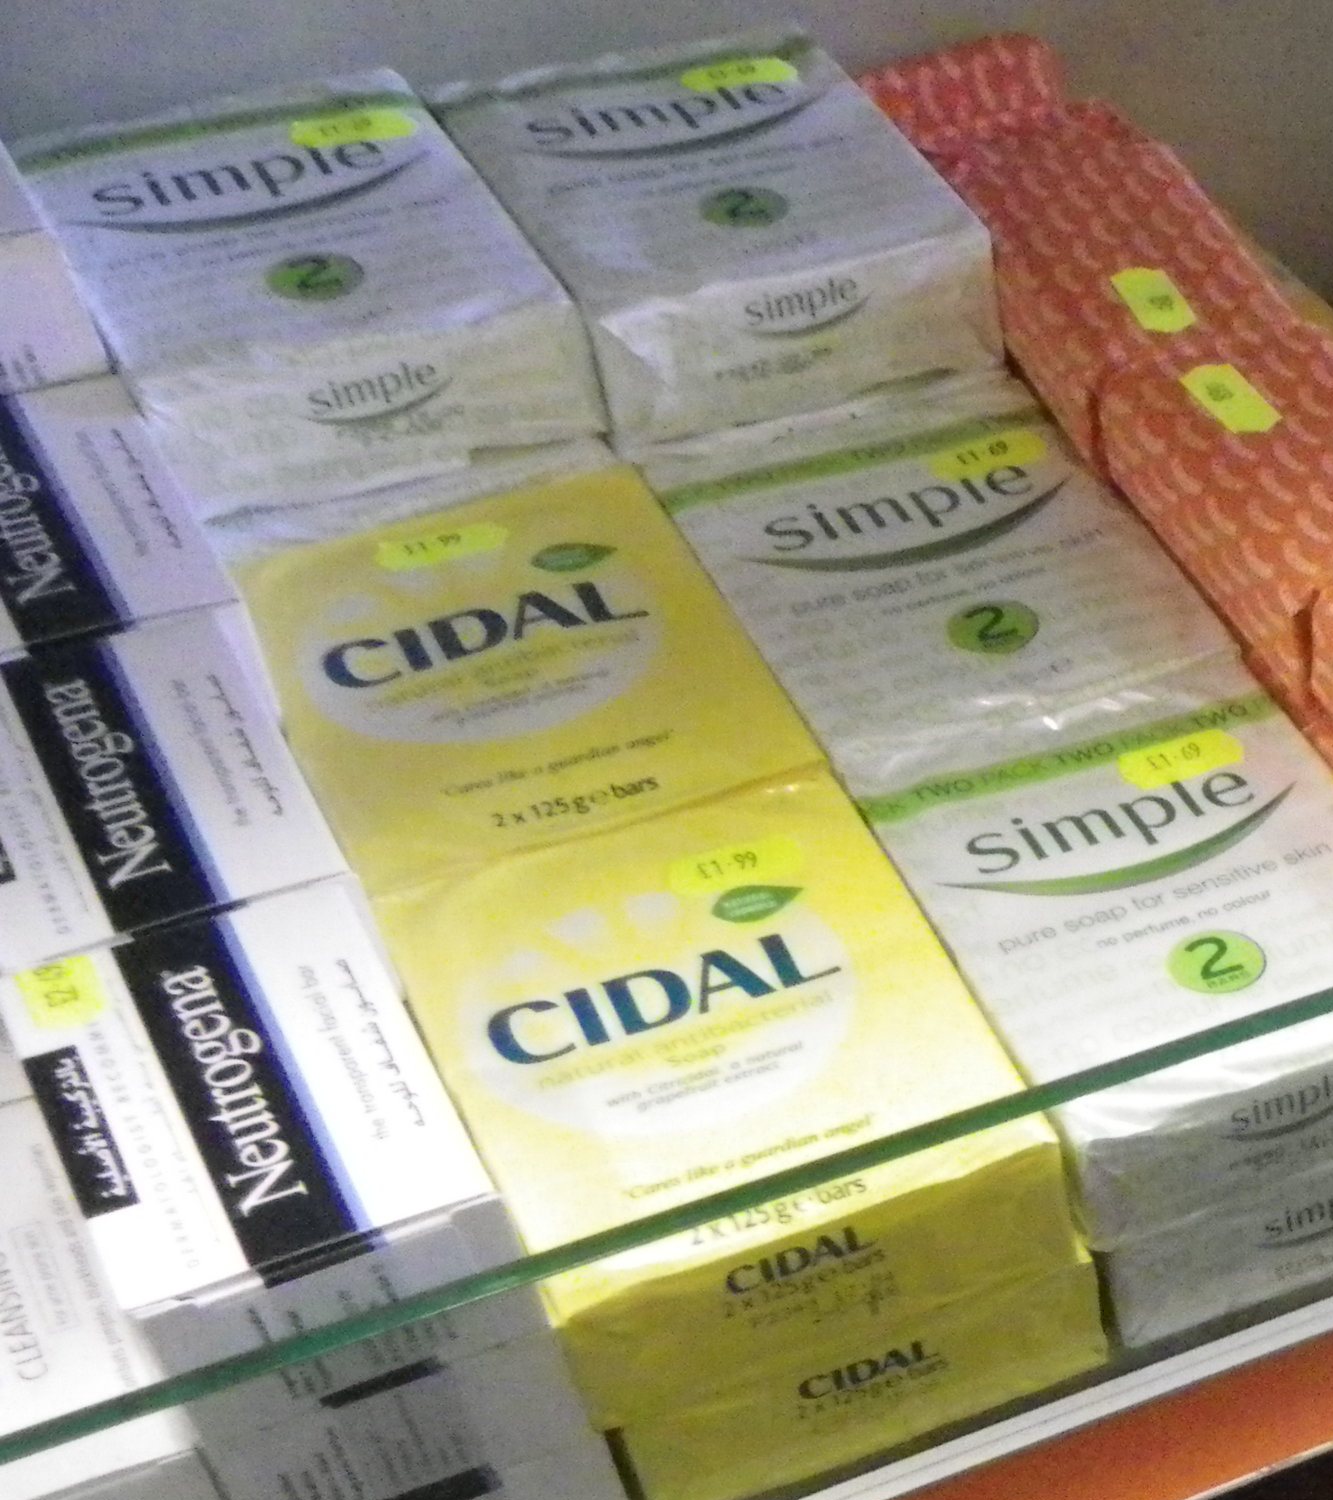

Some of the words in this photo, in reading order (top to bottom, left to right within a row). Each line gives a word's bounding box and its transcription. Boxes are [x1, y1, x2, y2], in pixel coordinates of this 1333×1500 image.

[527, 80, 785, 144] simple
[93, 142, 383, 217] simple
[744, 276, 859, 326] simple
[307, 362, 438, 416] simple
[0, 452, 76, 604] Neutroge
[765, 464, 1036, 552] simple
[323, 581, 649, 688] CIDAL
[965, 607, 1019, 643] 2
[45, 679, 172, 890] Neutrogena
[611, 776, 659, 801] bars
[915, 779, 975, 798] TWO
[1057, 740, 1115, 765] TWO
[966, 771, 1255, 875] simple
[699, 850, 758, 880] £1.99
[998, 924, 1058, 955] pure
[1064, 902, 1129, 934] soap
[1132, 891, 1167, 913] for
[1174, 860, 1279, 903] sensitive
[1284, 839, 1333, 868] skin
[1184, 936, 1244, 981] 2
[487, 933, 842, 1065] CIDAL
[162, 964, 308, 1217] Neutrogena
[329, 1033, 377, 1114] transparent
[816, 1178, 868, 1203] bars
[724, 1226, 877, 1295] CIDAL
[798, 1341, 940, 1400] CIDAL
